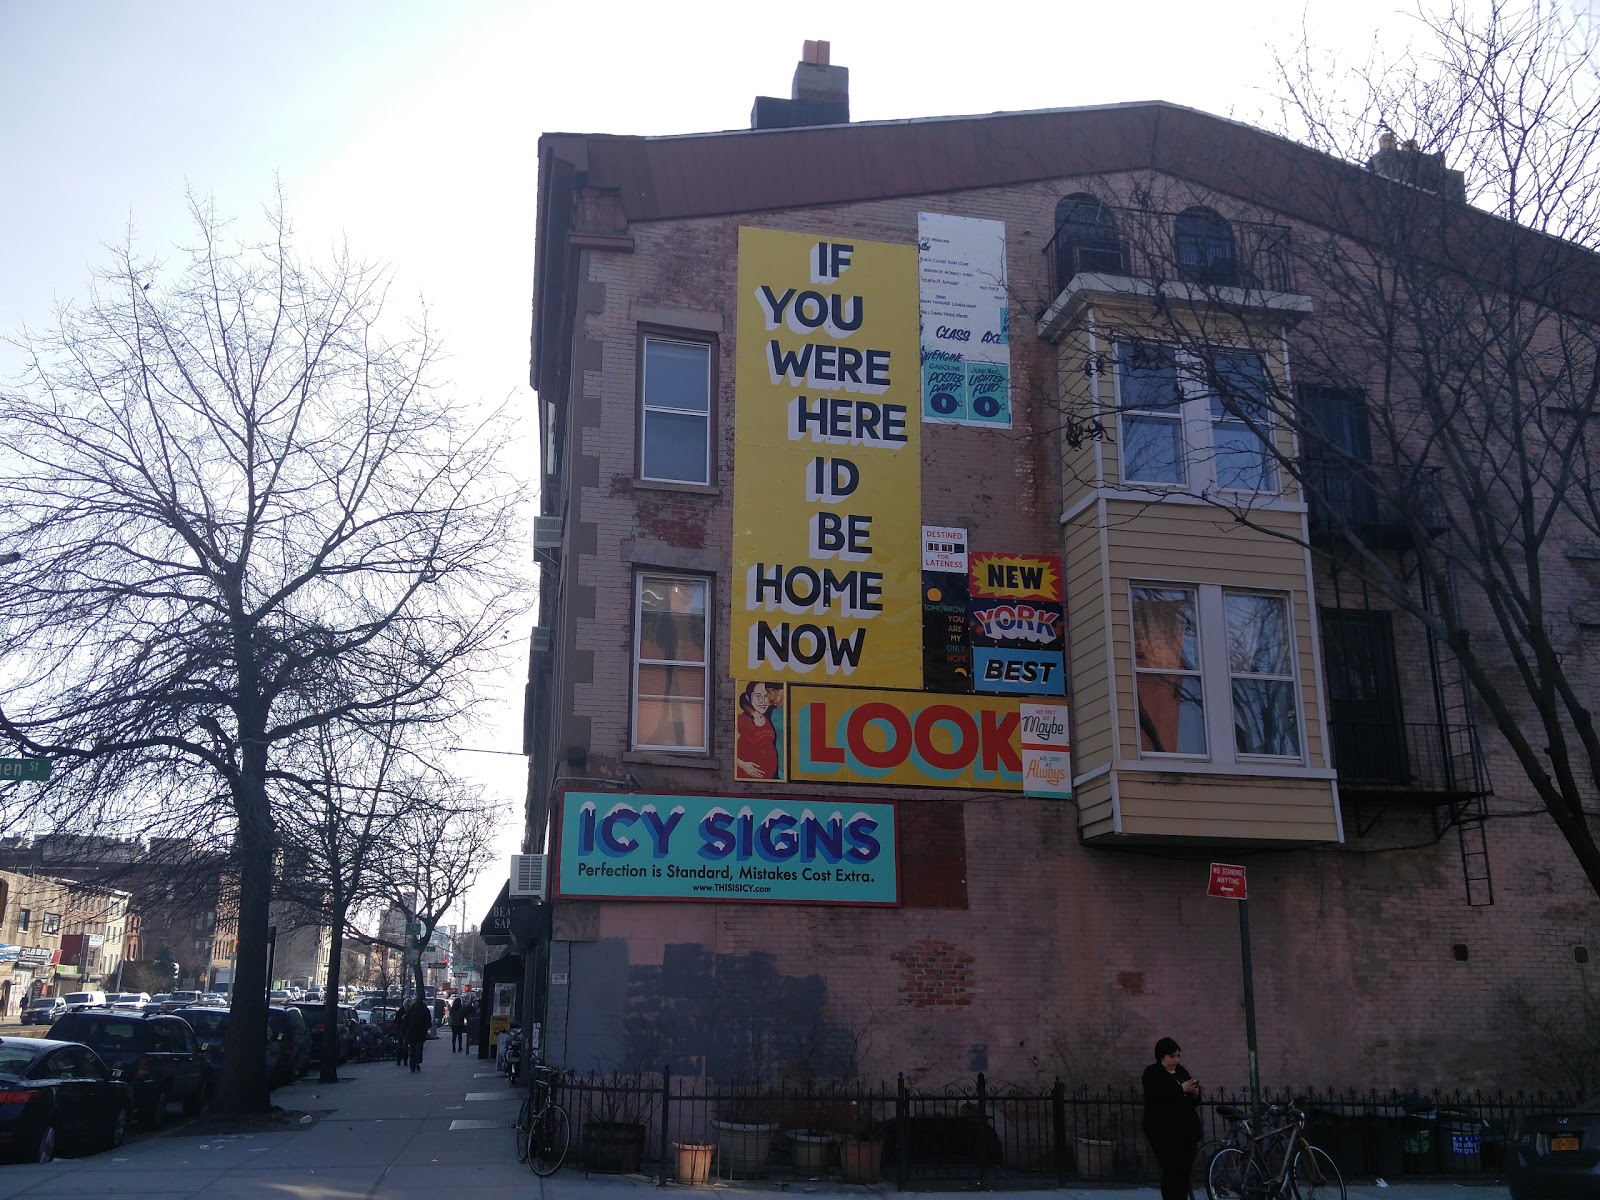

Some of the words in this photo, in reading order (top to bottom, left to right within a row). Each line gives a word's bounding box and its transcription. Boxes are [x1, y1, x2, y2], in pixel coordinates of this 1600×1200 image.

[810, 241, 854, 285] IF
[754, 285, 864, 339] YOU
[936, 326, 971, 342] CLASS
[765, 340, 891, 395] WERE
[928, 363, 960, 371] GASOLINE
[928, 372, 964, 386] POSTER
[968, 374, 1004, 386] LIGHTER
[929, 384, 962, 396] PAINT
[973, 384, 1000, 397] FLUID
[787, 395, 908, 449] HERE
[806, 456, 860, 504] ID
[808, 511, 873, 562] BE
[926, 530, 963, 540] DESTINED
[926, 559, 963, 568] LATENESS
[987, 563, 1044, 590] NEW
[746, 562, 883, 620] HOME
[924, 604, 966, 613] TOMORROW
[948, 615, 965, 623] YOU
[972, 604, 1060, 644] YORK
[950, 634, 962, 642] MY
[747, 620, 866, 676] NOW
[946, 644, 966, 652] ONLY
[946, 654, 968, 663] HOPE
[984, 660, 1057, 685] BEST
[1022, 716, 1064, 740] Maybe
[798, 701, 1023, 782] LOOK
[29, 761, 40, 771] St
[1026, 759, 1065, 786] Always
[578, 800, 686, 860] ICY
[696, 805, 881, 864] SIGNS
[578, 862, 648, 878] Perfection
[652, 864, 662, 878] is
[666, 864, 733, 882] Standard,
[739, 866, 798, 882] Mistakes
[802, 868, 831, 882] Cost
[835, 869, 875, 883] Extra.
[1216, 876, 1240, 885] ANYTIME
[1222, 868, 1243, 877] STANDING
[692, 883, 771, 894] www.THISISICY.com
